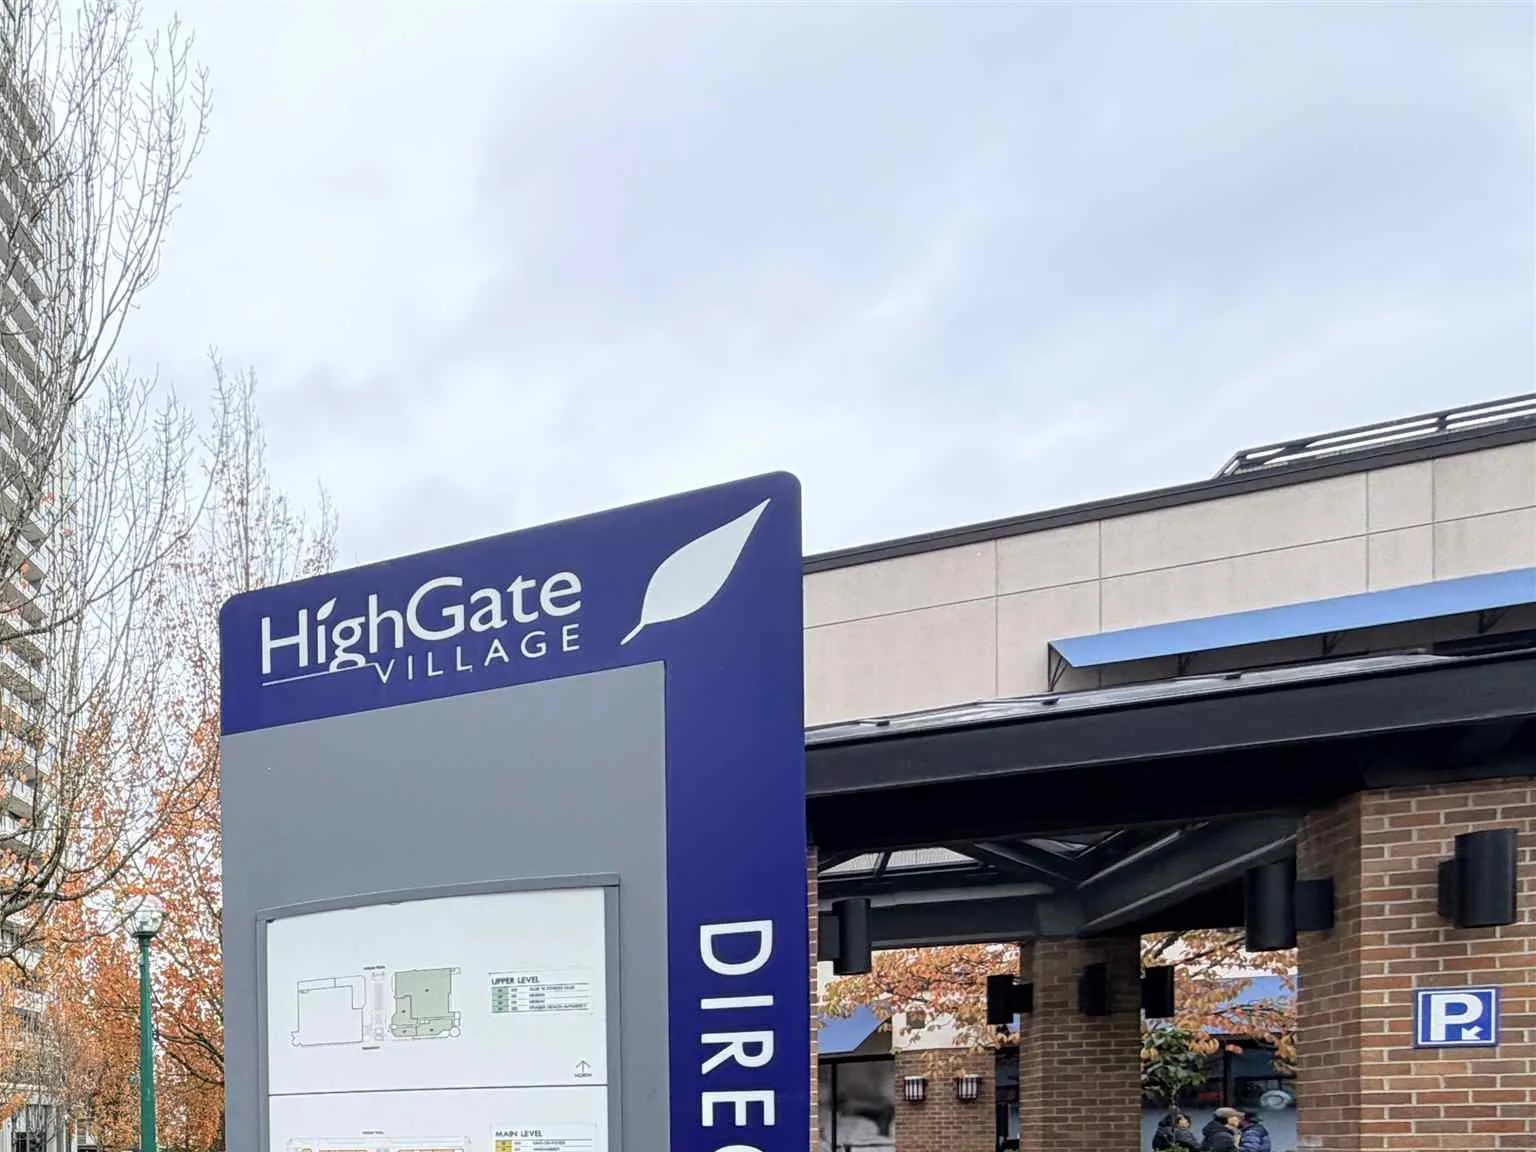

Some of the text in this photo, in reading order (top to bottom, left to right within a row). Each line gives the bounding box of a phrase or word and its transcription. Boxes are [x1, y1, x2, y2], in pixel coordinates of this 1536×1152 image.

[260, 570, 582, 674] HighGate
[375, 624, 581, 684] VILLAGE
[491, 976, 540, 985] UPPER LEVEL
[1430, 993, 1484, 1041] P
